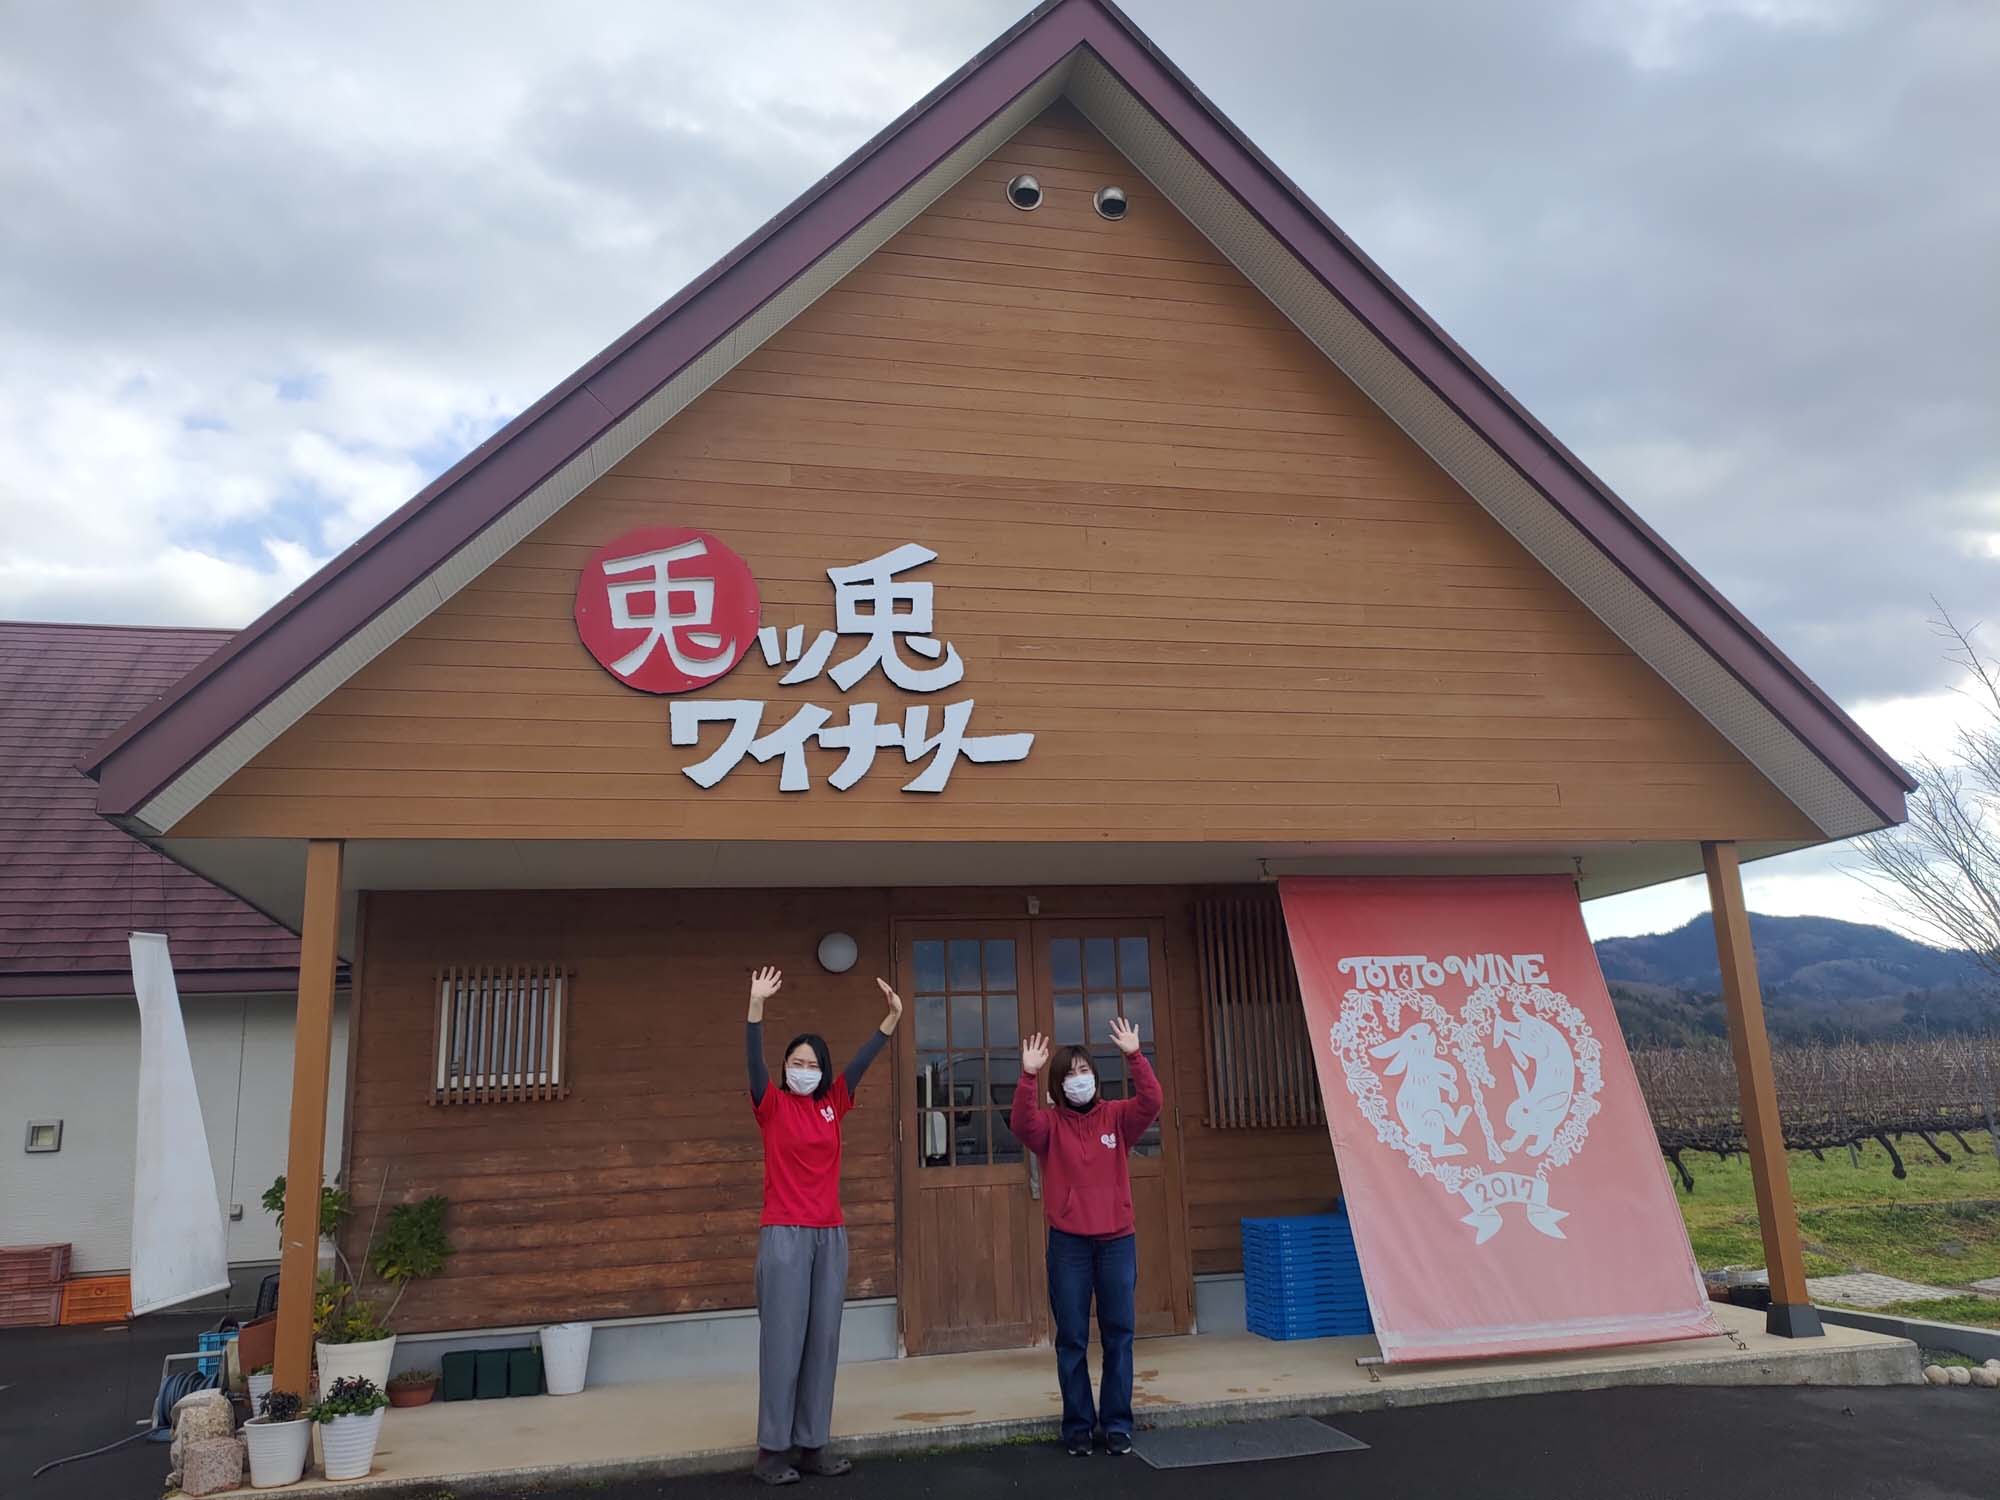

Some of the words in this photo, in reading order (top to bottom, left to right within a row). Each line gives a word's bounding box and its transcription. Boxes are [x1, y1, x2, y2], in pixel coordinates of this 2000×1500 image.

[670, 699, 1034, 792] ワイナリー
[1338, 955, 1445, 989] TOTTO
[1443, 953, 1550, 987] WINE
[1475, 1176, 1534, 1203] 2017
